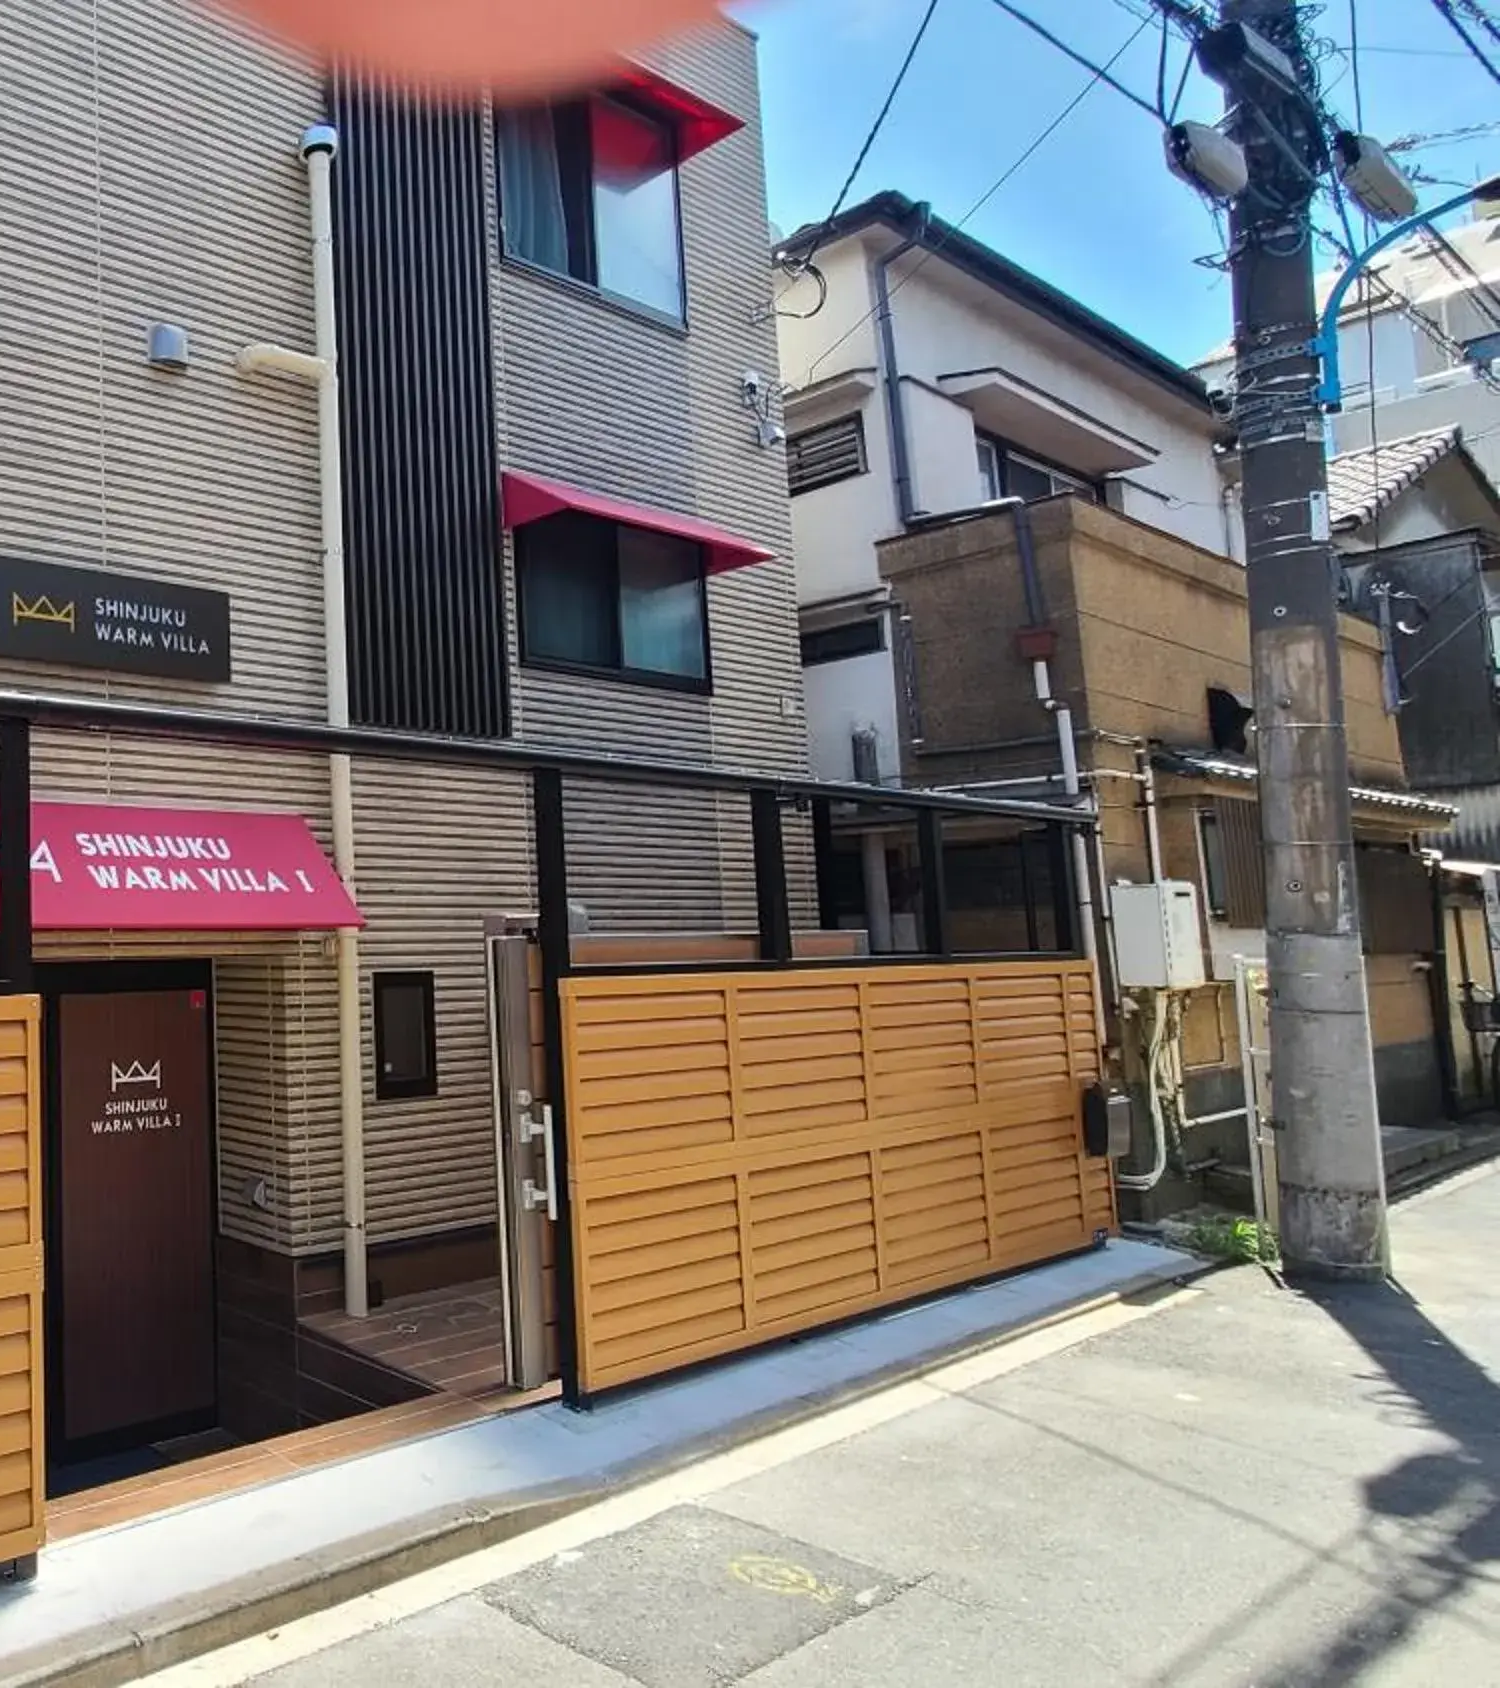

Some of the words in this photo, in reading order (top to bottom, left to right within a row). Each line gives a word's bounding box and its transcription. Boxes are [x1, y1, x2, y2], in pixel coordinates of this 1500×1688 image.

[95, 598, 185, 626] SHINJUKU
[95, 623, 154, 648] WARM
[161, 633, 210, 655] VILLA
[75, 832, 232, 860] SHINJUKU
[88, 863, 198, 892] WARM
[198, 868, 291, 893] VILLA
[105, 1098, 167, 1115] SHINJUKU
[91, 1119, 133, 1134] WARM
[136, 1115, 171, 1130] VILLA
